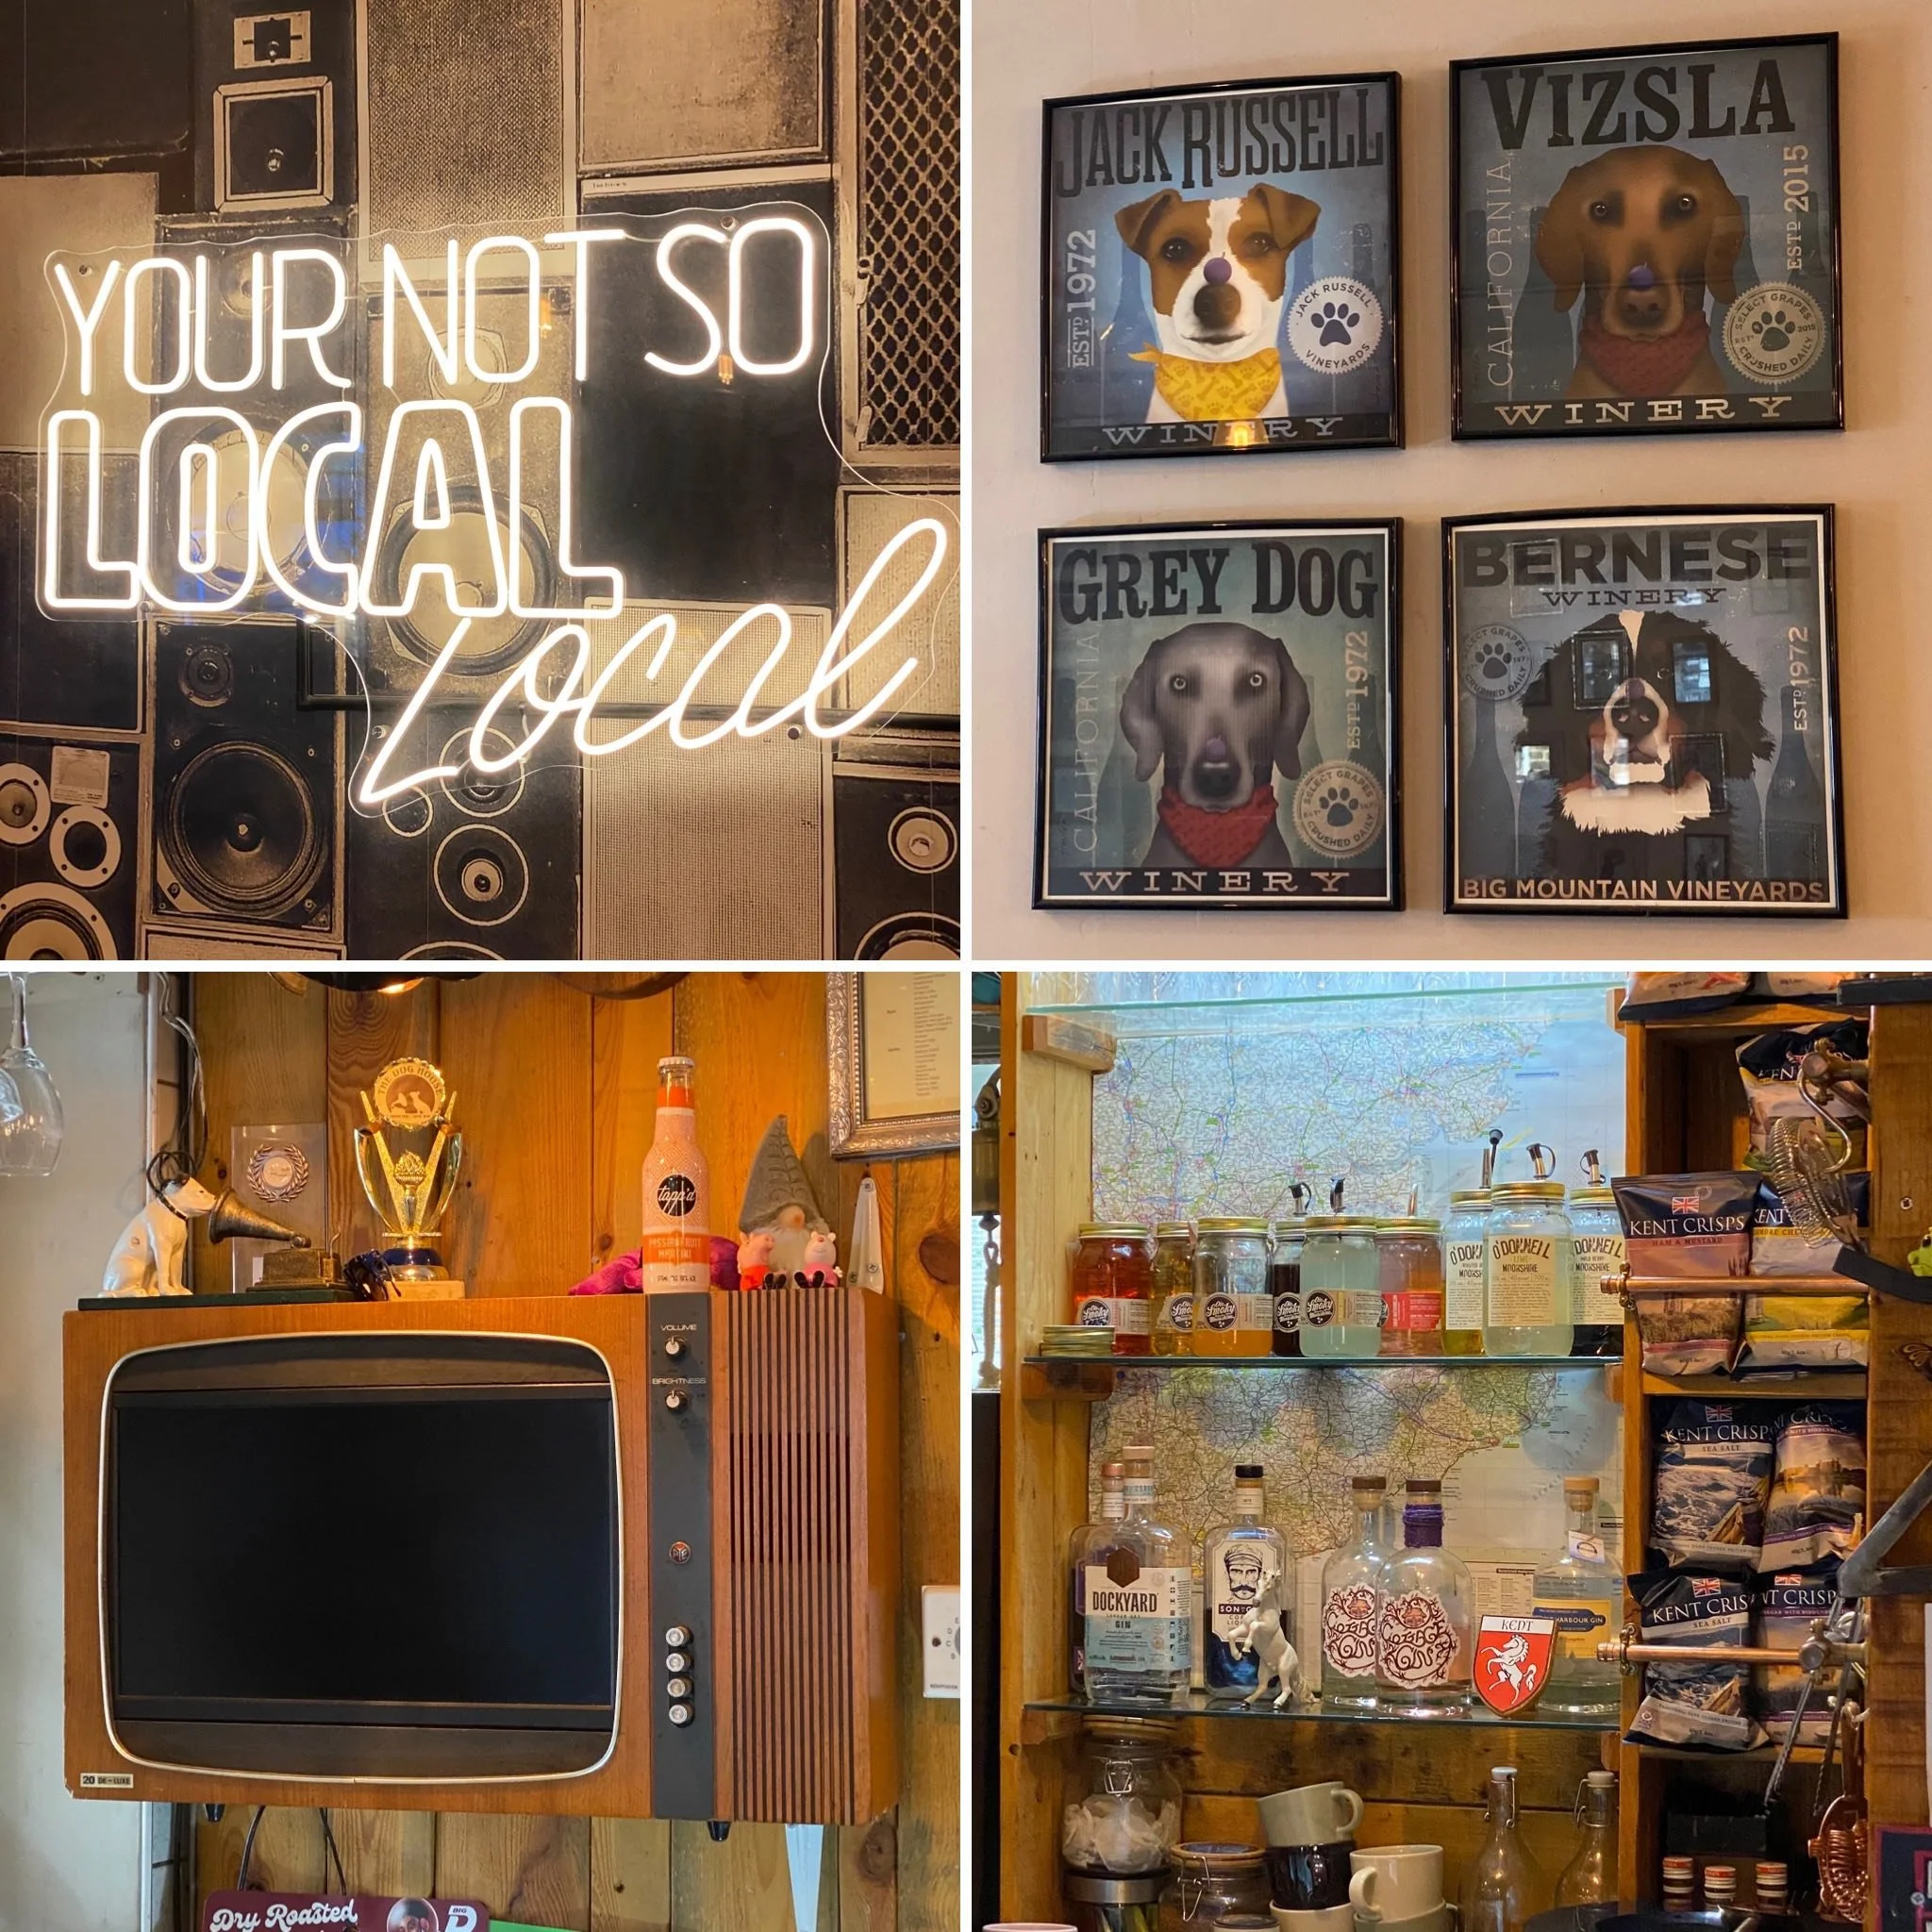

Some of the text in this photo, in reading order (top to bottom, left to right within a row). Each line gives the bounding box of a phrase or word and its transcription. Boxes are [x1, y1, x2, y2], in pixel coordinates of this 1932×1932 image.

[1481, 58, 1796, 151] VIZSLA
[1056, 87, 1385, 198] JACK RUSSELL
[1783, 143, 1810, 213] 2015
[1067, 228, 1096, 313] 1972
[1487, 161, 1514, 388] CALIFORNIA
[54, 216, 823, 396] YOUR NOT SO
[1296, 282, 1373, 318] JACK RUSSELL
[1735, 292, 1812, 331] SELECT GRAPES
[1797, 323, 1817, 333] 2015
[1306, 343, 1371, 369] VINEYARDS
[1739, 336, 1813, 373] CRUSHED DAILY
[1494, 395, 1793, 426] WINERY
[43, 394, 626, 621] LOCAL
[1462, 527, 1812, 589] BERNESE
[1058, 541, 1380, 625] GREY DOG
[1542, 587, 1726, 608] WINERY
[1491, 627, 1526, 653] GRAPES
[358, 517, 948, 806] Local
[1344, 629, 1370, 699] 1972
[1788, 625, 1810, 689] 1972
[1507, 666, 1527, 693] DAILY
[1074, 631, 1100, 854] CALIFORNIA
[1304, 770, 1374, 806] SELECT GRAPES
[1307, 813, 1375, 847] CRUSHED DAILY
[1079, 872, 1350, 893] WINERY
[1463, 878, 1824, 902] BIG MOUNTAIN VINEYARDS
[377, 1065, 442, 1095] THE DOG HOUSE
[657, 1184, 696, 1216] tapp'd
[1630, 1215, 1745, 1236] KENT CRISPS
[1492, 1238, 1551, 1260] O'DONNELL
[1502, 1263, 1539, 1273] MOONSHINE
[1207, 1302, 1236, 1318] Smoky
[1307, 1298, 1333, 1313] Smoky
[1665, 1425, 1713, 1442] KENT
[1092, 1591, 1158, 1613] DOCKYARD
[1220, 1605, 1241, 1613] SON
[1653, 1594, 1748, 1624] KENT CRIS
[1115, 1620, 1132, 1629] GIN
[1712, 1617, 1732, 1625] SALT
[82, 1775, 95, 1785] 20
[209, 1898, 359, 1932] Dry Roasted
